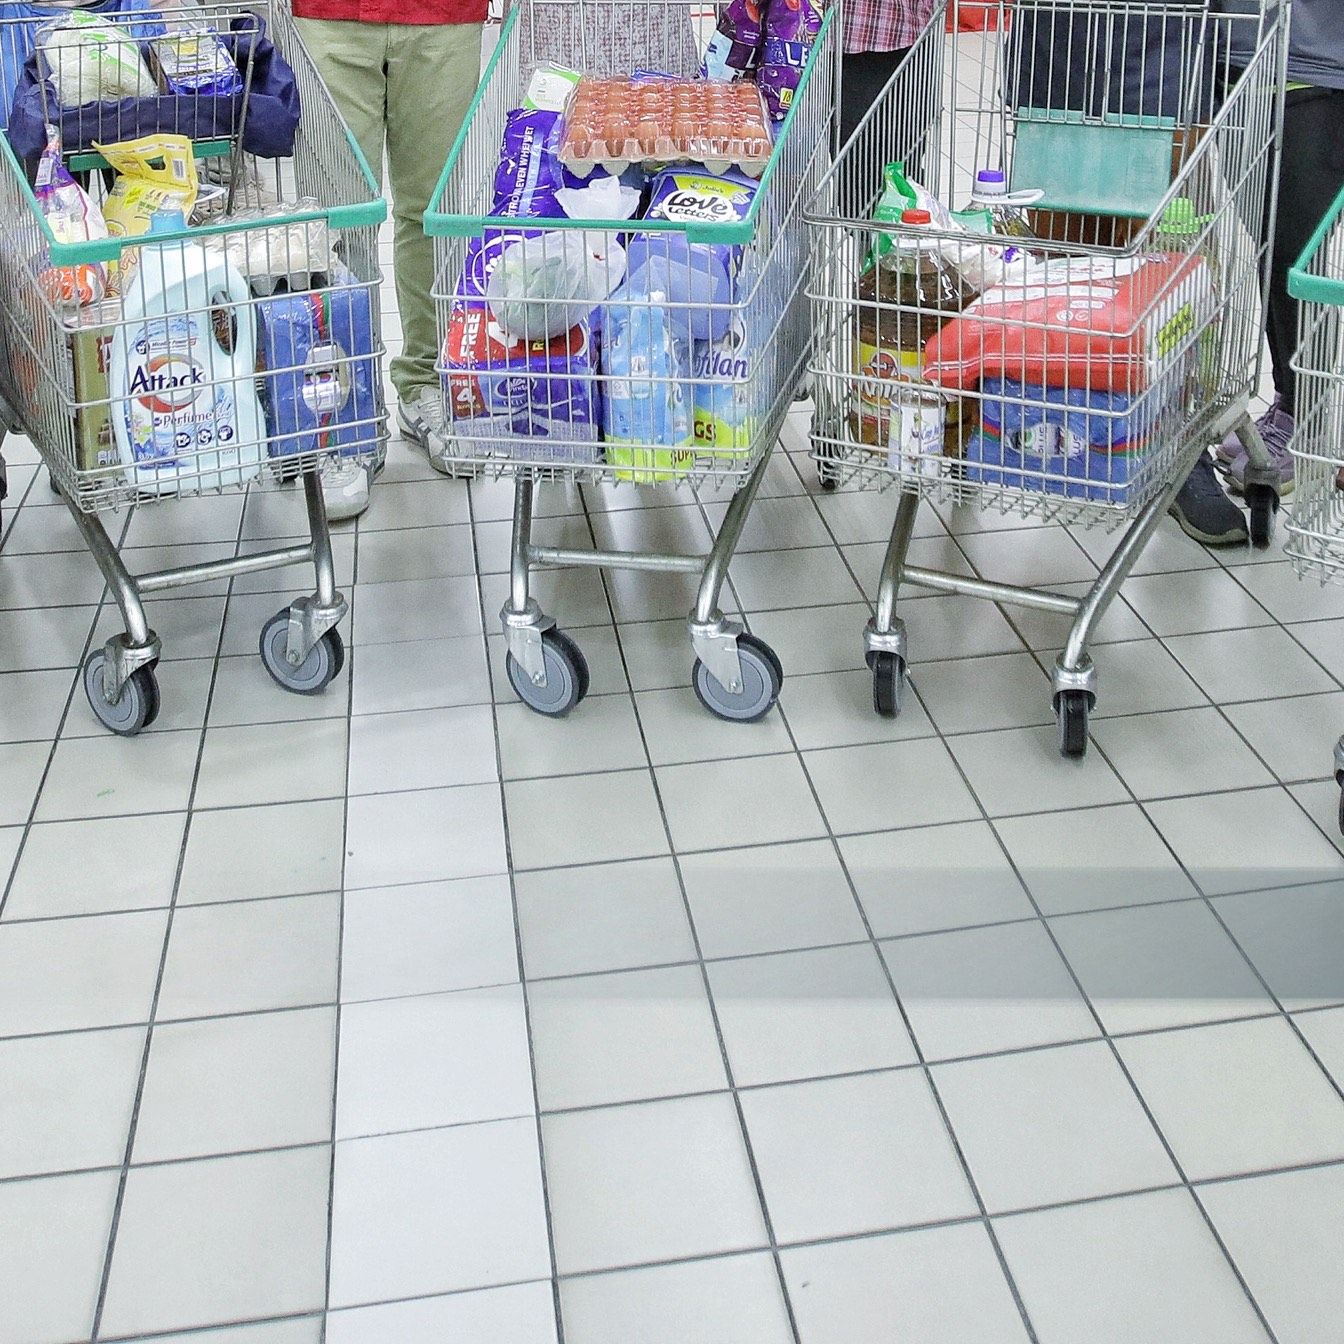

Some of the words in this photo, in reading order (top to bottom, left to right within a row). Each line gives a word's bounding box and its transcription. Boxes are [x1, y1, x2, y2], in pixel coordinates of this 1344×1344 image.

[668, 191, 729, 215] Love
[459, 312, 481, 359] FREE
[130, 365, 204, 393] Attack
[456, 387, 477, 403] 4
[162, 412, 215, 428] Perfume
